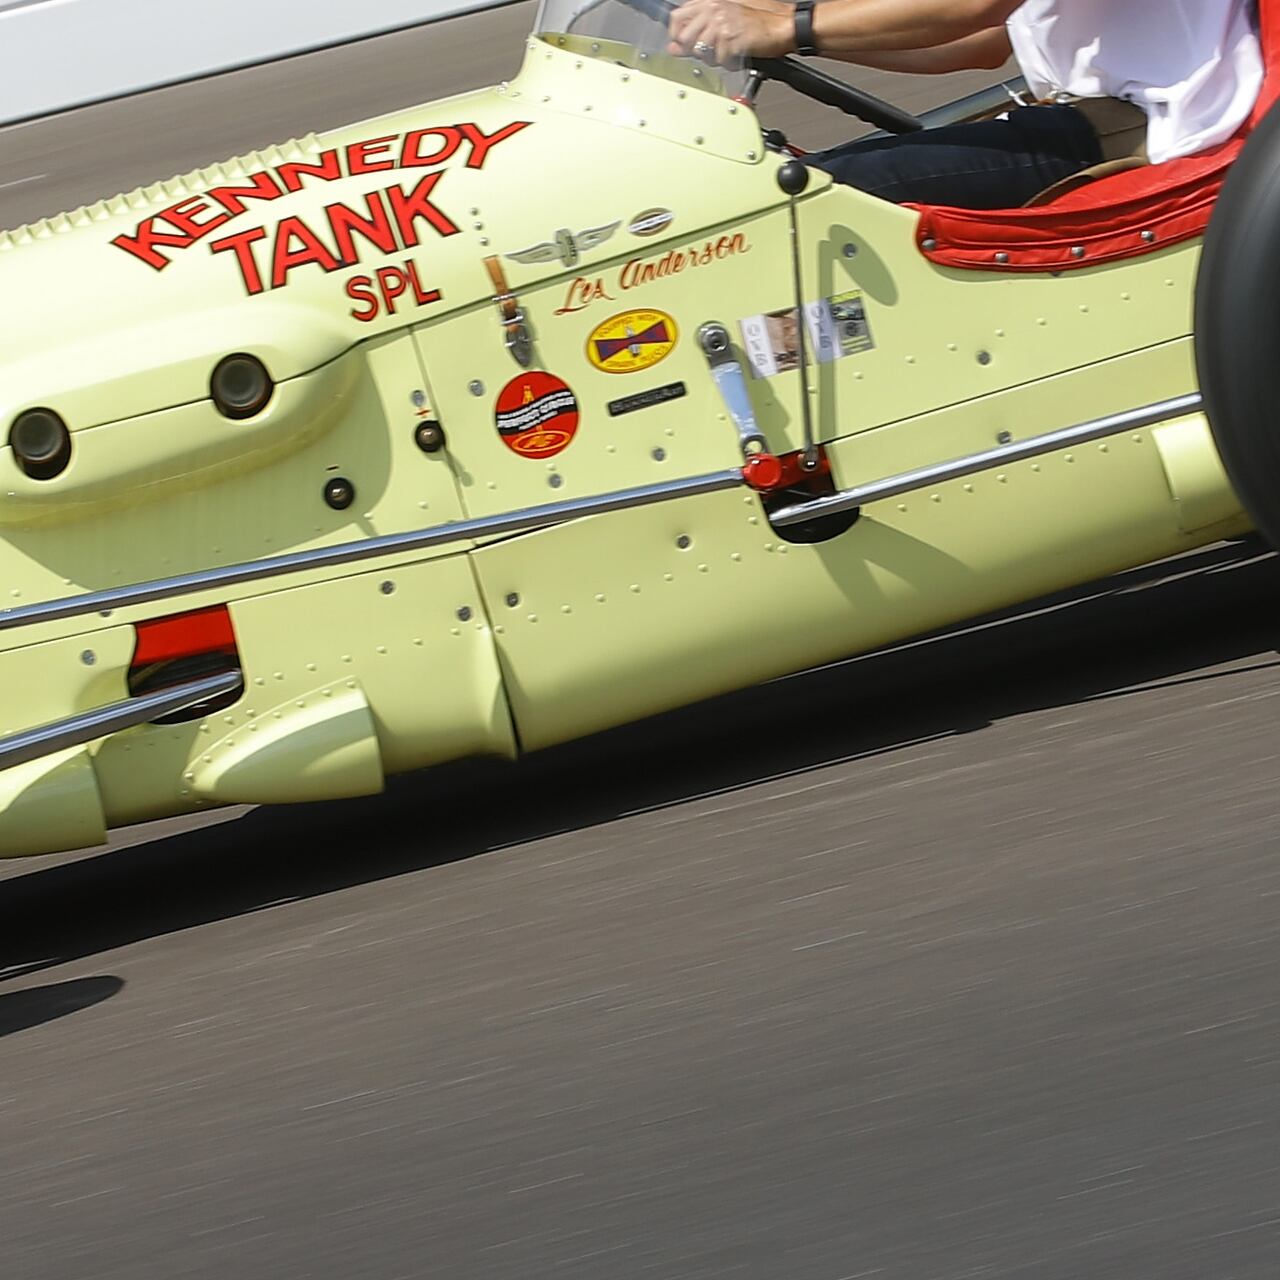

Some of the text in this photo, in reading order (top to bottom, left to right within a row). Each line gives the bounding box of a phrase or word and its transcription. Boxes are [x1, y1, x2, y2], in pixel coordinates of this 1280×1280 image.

[110, 121, 535, 271] KENNEDY
[209, 168, 462, 297] TANK
[345, 259, 443, 322] SPL
[553, 277, 616, 315] Les
[620, 233, 752, 291] Anderson
